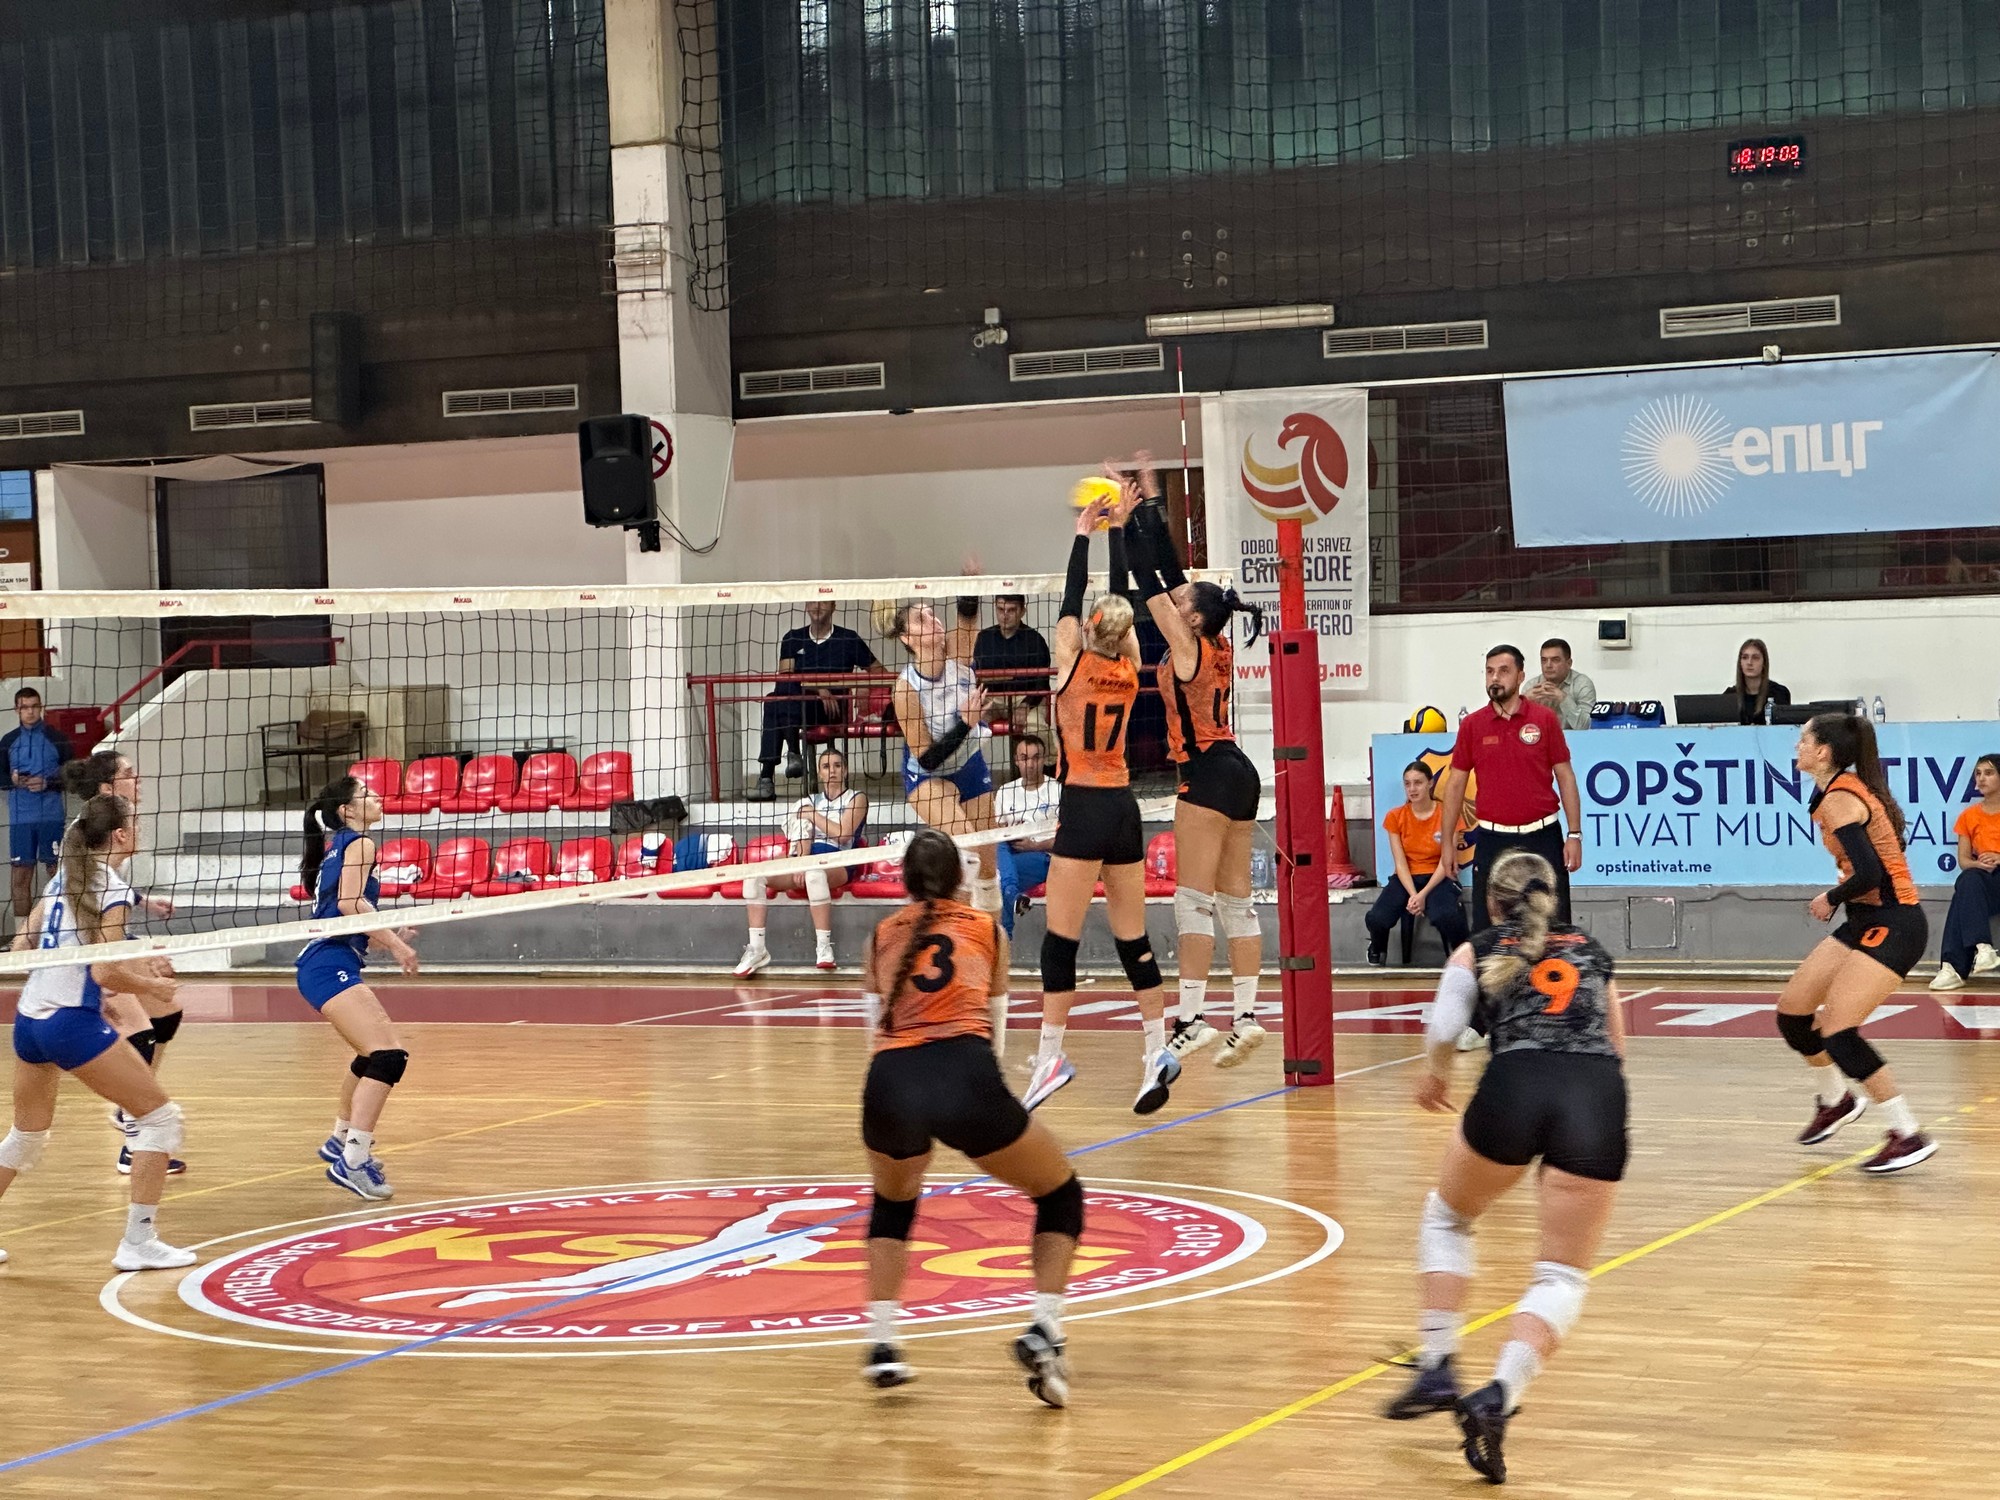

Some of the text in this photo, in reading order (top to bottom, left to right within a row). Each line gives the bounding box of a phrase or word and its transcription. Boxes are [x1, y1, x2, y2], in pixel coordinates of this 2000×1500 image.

[1318, 537, 1352, 552] SAVEZ
[1241, 556, 1280, 584] CRN
[1304, 555, 1352, 582] GORE
[1342, 599, 1353, 610] OF
[1592, 704, 1611, 714] 20
[1640, 703, 1657, 714] 18
[1084, 703, 1125, 751] 17
[1586, 742, 1816, 806] OPŠTIN
[1587, 812, 1700, 847] TIVAT
[1595, 859, 1713, 877] opstinativat.me
[337, 970, 348, 982] 3
[911, 934, 954, 992] 3
[1529, 958, 1580, 1015] 9
[1083, 1197, 1202, 1222] CRNE
[1159, 1223, 1224, 1257] GORE
[223, 1242, 341, 1307] BASKETBALL
[258, 1303, 608, 1337] FEDERATION
[627, 1321, 727, 1336] OF
